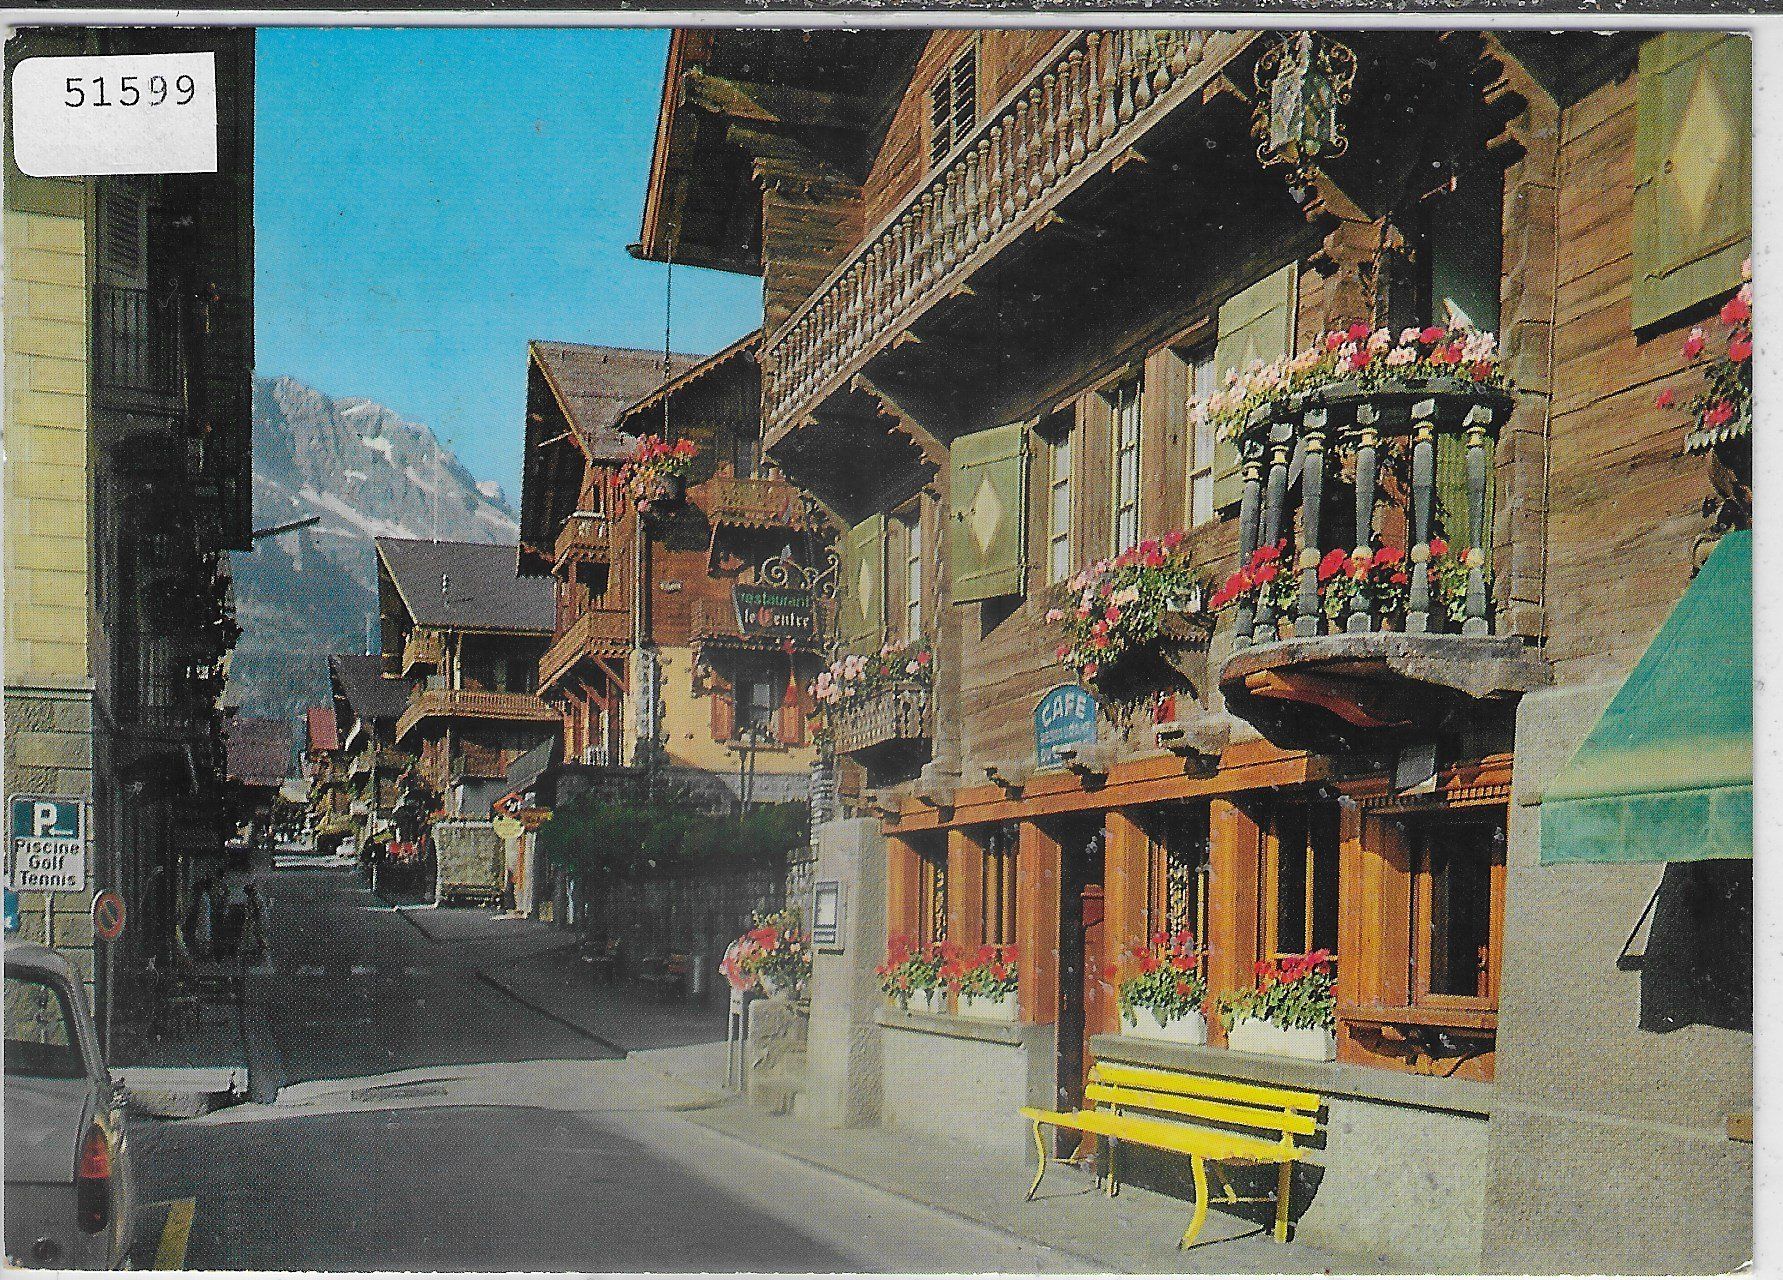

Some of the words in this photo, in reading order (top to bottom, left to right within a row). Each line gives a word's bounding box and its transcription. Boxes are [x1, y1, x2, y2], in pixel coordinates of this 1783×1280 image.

[744, 607, 756, 624] le
[34, 803, 57, 837] P
[15, 839, 79, 854] Piscine
[28, 854, 65, 870] Golf
[20, 870, 76, 886] Tennis
